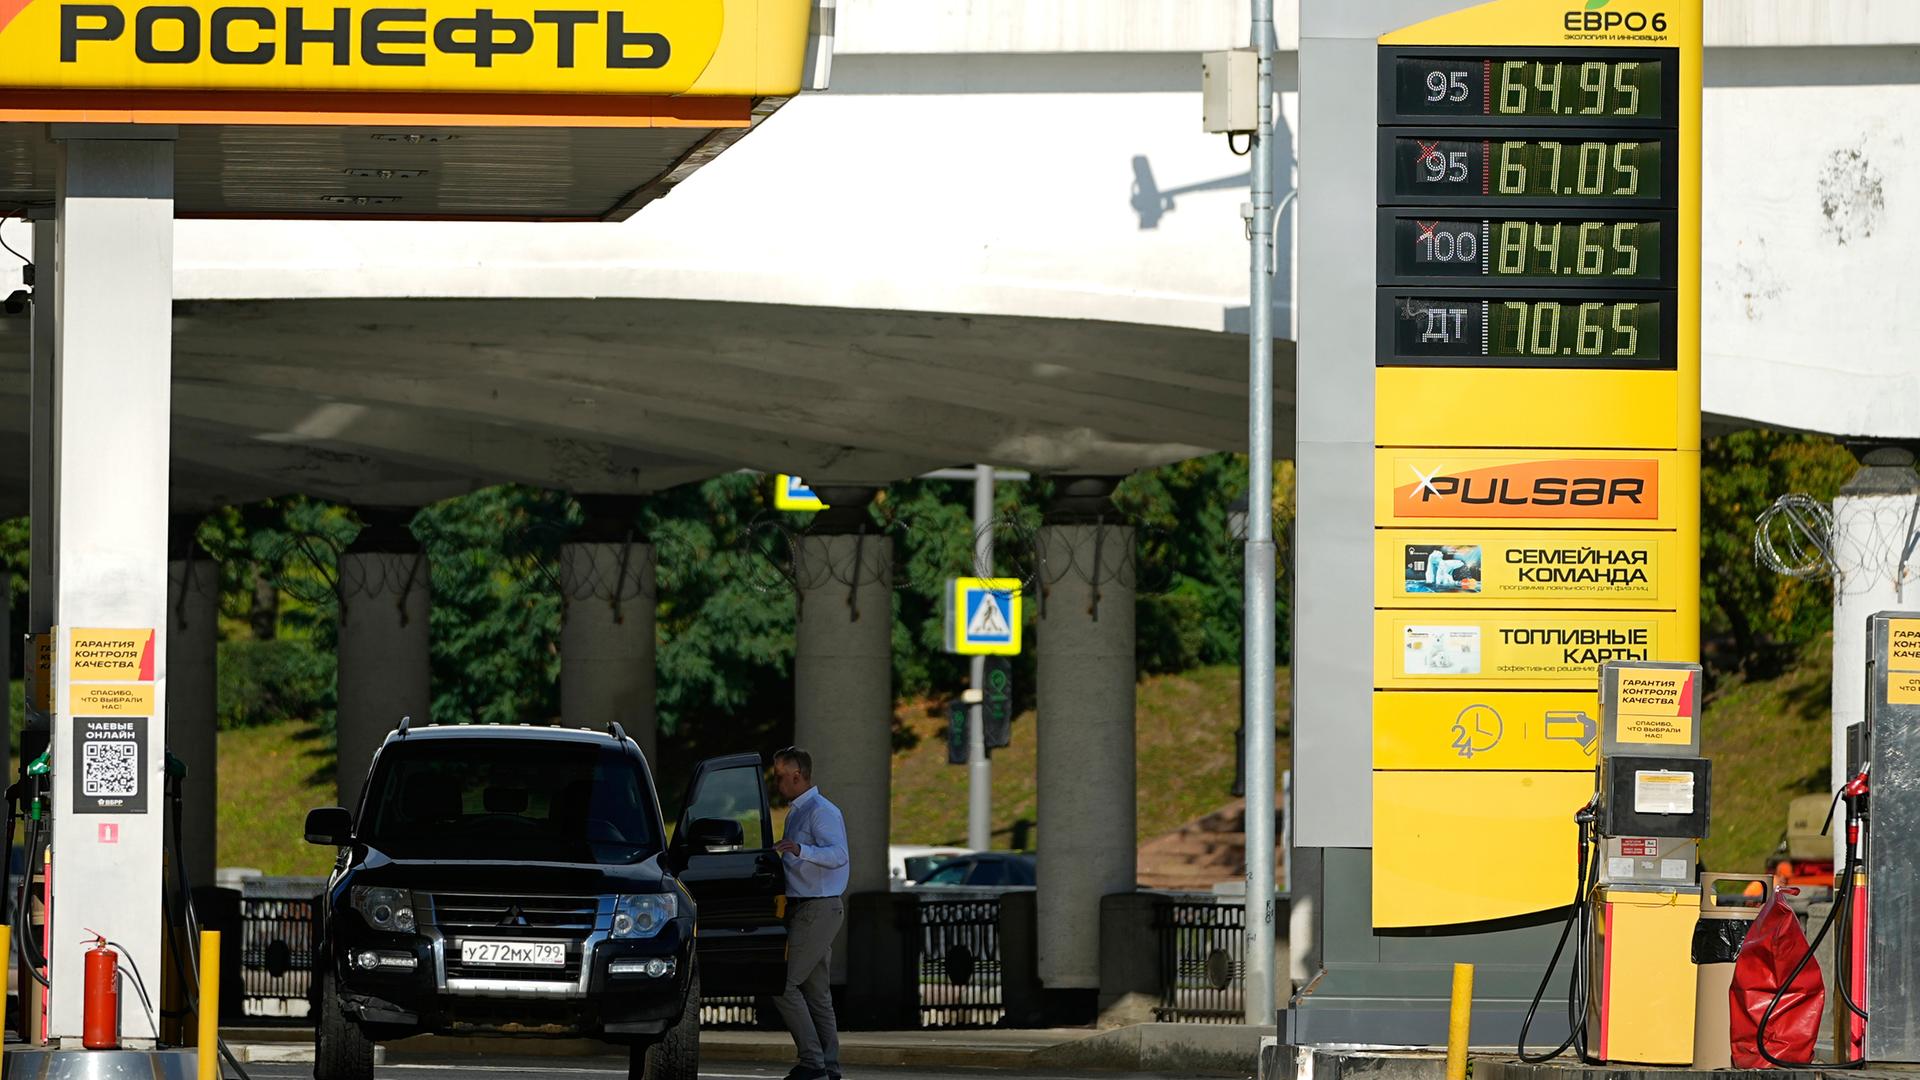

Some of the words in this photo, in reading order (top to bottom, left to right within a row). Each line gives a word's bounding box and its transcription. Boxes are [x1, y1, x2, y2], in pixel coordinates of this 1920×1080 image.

[1564, 11, 1647, 31] ЕВРО
[1651, 12, 1667, 32] 6
[59, 4, 671, 69] РОСНЕФТЬ
[1617, 34, 1668, 42] ИННОВАЦИИ
[1426, 70, 1469, 102] 95
[1499, 61, 1640, 115] 64.95
[1425, 151, 1468, 182] 95
[1499, 141, 1639, 195] 67.05
[1419, 231, 1477, 262] 100
[1498, 221, 1639, 275] 84.65
[1422, 308, 1468, 343] ДТ
[1504, 301, 1639, 355] 70.65
[1505, 547, 1648, 565] СЕМЕЙНАЯ
[1518, 567, 1648, 585] КОМАНДА
[1499, 584, 1544, 592] программа
[75, 640, 135, 648] ГАРАНТИЯ
[1499, 629, 1648, 645] ТОПЛИВНЫЕ
[75, 650, 138, 658] КОНТРОЛЯ
[1564, 649, 1648, 664] КАРТЫ
[75, 660, 134, 668] КАЧЕСТВА
[1622, 679, 1676, 687] ГАРАНТИЯ
[1622, 688, 1678, 696] КОНТРОЛЯ
[81, 696, 99, 704] ЧТО
[99, 696, 144, 704] ВЫБРАЛИ
[1622, 697, 1675, 705] КАЧЕСТВА
[87, 722, 134, 730] ЧАЕВЫЕ
[85, 731, 136, 739] ОНЛАЙН
[1451, 724, 1474, 759] 24
[468, 944, 532, 962] У272МХ
[536, 944, 561, 958] 799
